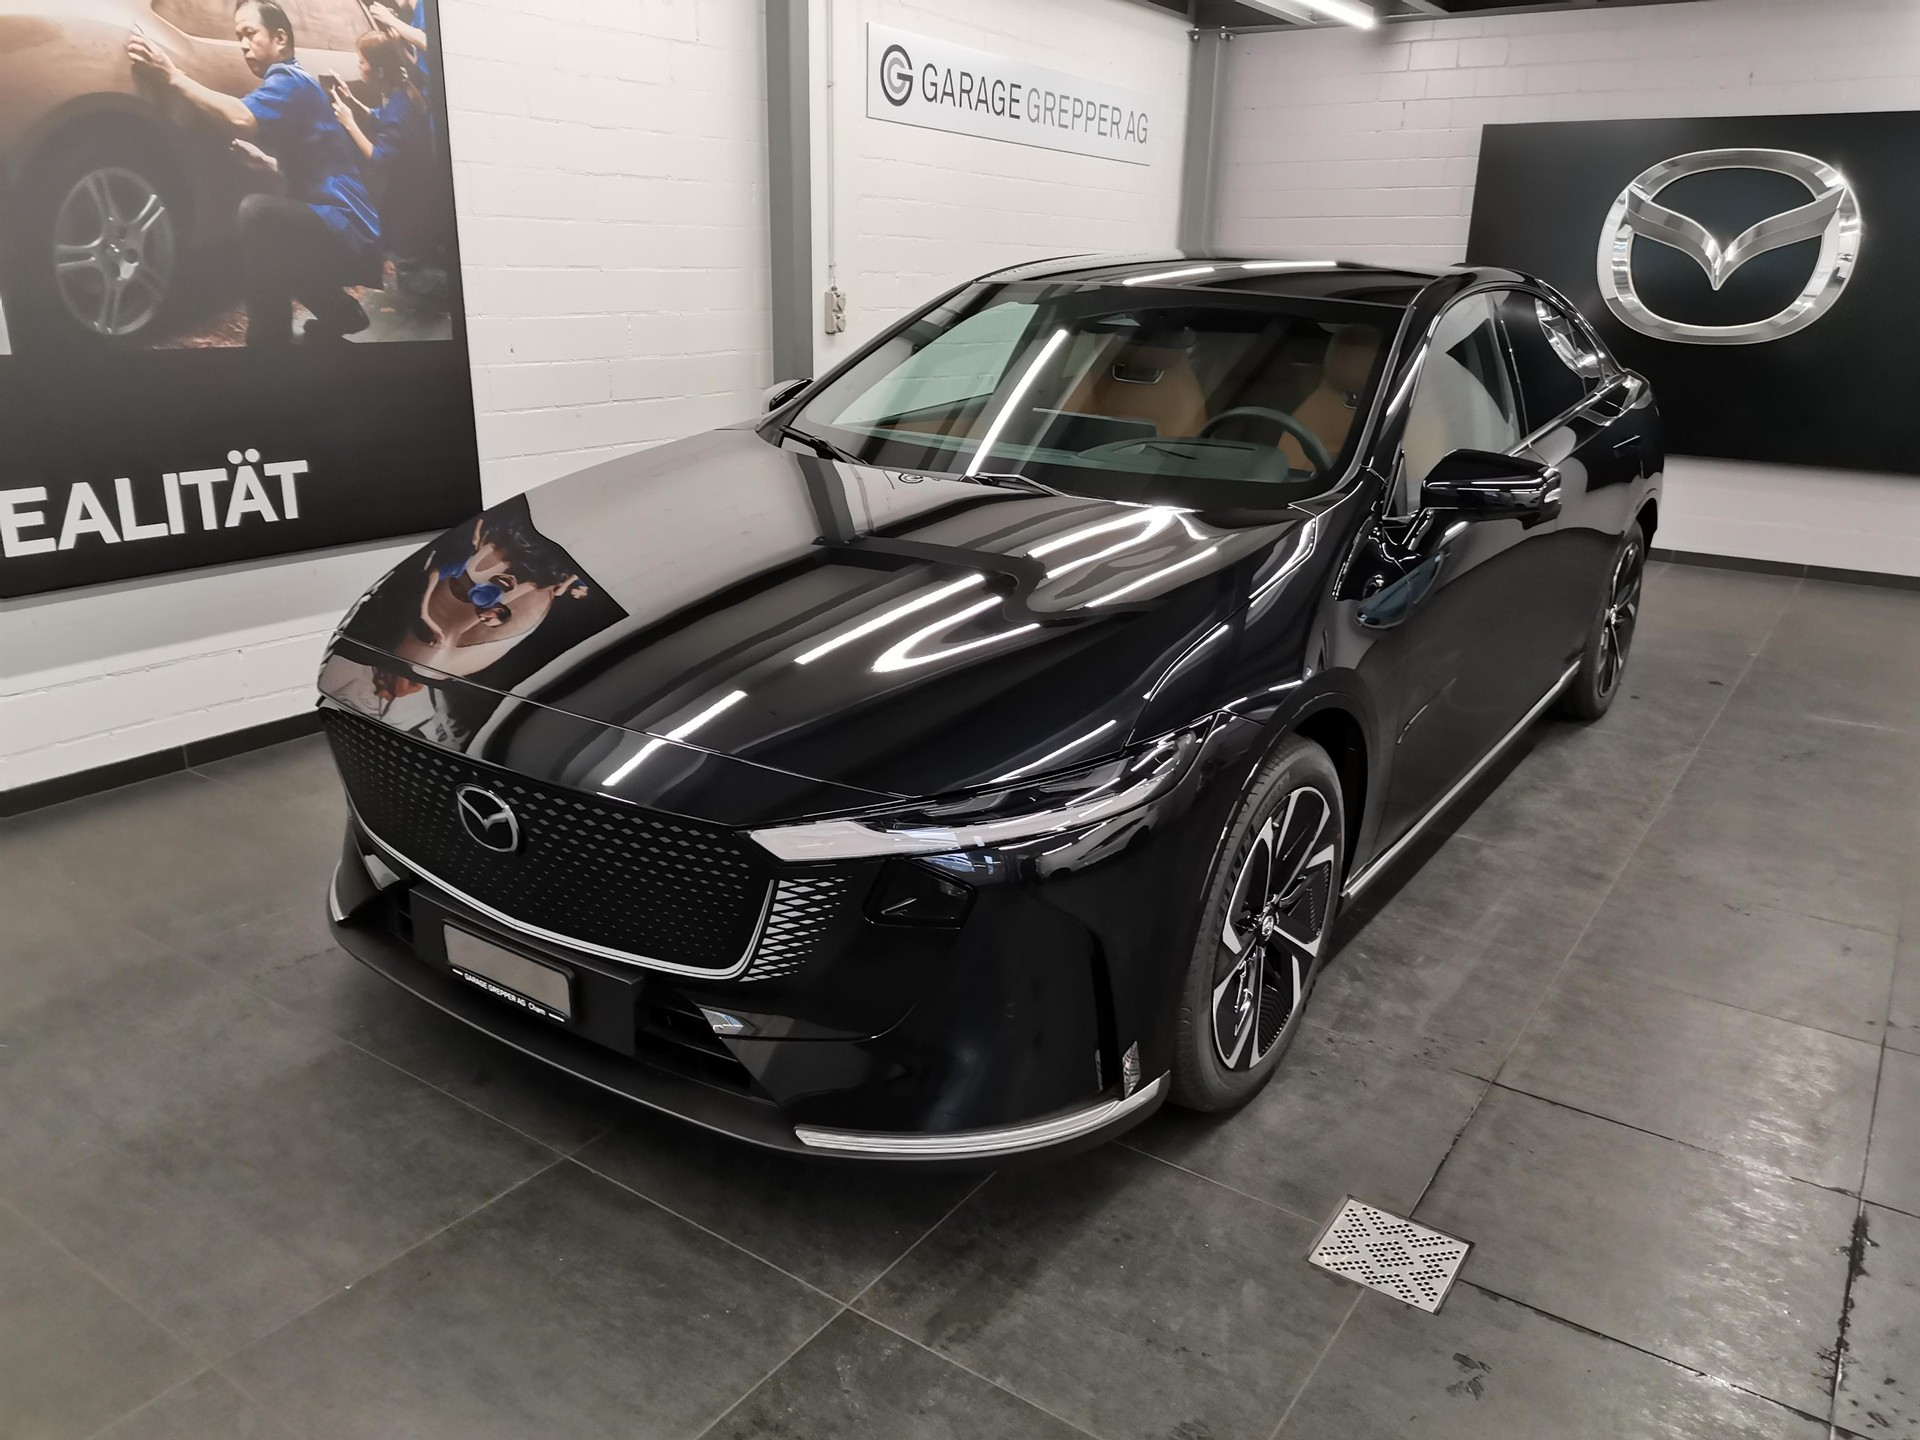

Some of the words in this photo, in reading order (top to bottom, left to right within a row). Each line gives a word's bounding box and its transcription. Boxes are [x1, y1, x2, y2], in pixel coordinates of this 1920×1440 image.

[921, 62, 1022, 119] GARAGE
[1026, 87, 1121, 139] GREPPER
[1124, 110, 1149, 144] AG
[464, 973, 488, 990] GARAGE
